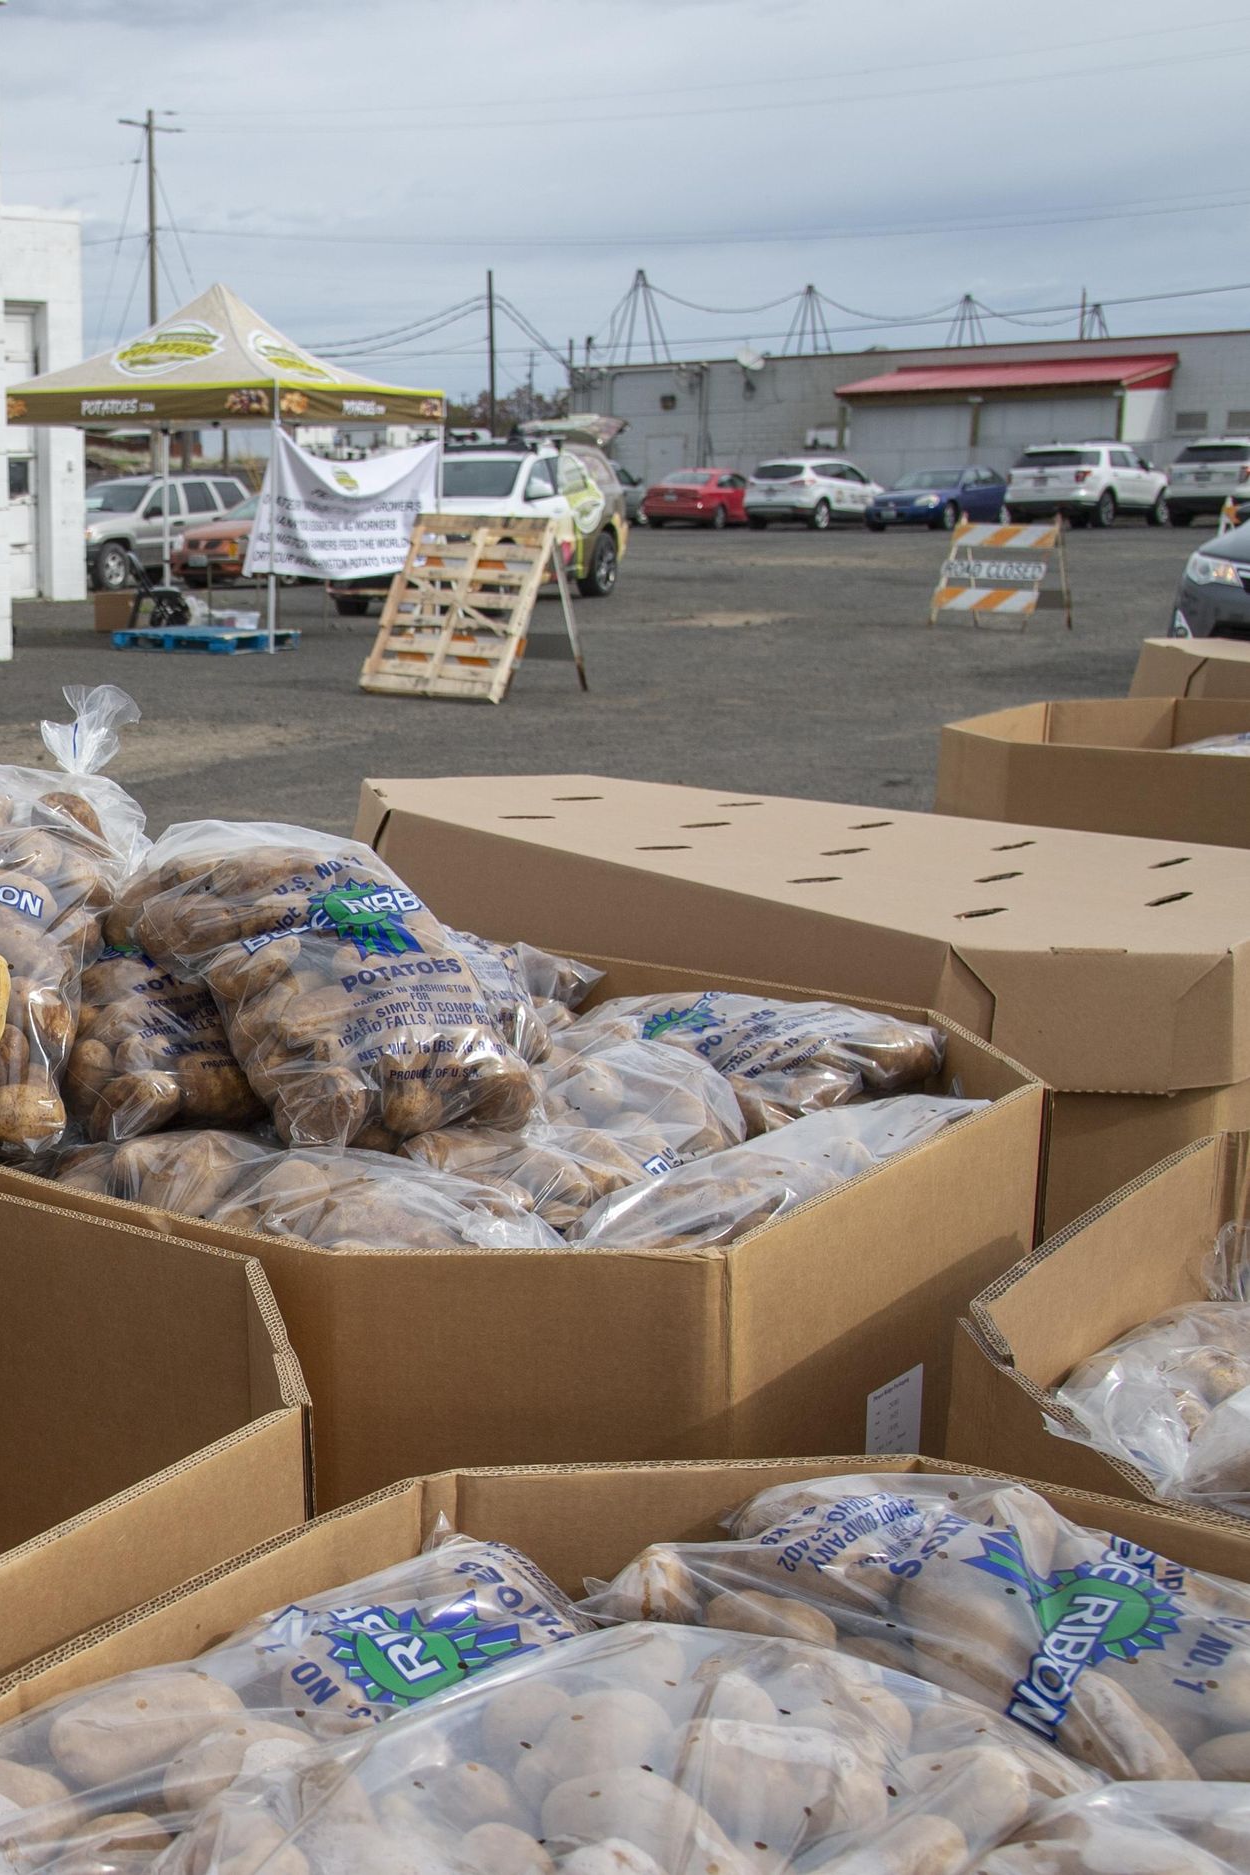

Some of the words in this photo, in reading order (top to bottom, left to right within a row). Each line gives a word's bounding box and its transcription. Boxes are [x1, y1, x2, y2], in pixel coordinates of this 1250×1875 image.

[80, 399, 139, 416] POTATOES
[986, 561, 1043, 580] CLOSED
[272, 876, 314, 895] U.S.
[314, 859, 350, 881] NO.
[340, 890, 422, 915] RIBB
[340, 958, 462, 993] POTATOES
[353, 989, 394, 1008] PACKED
[396, 986, 408, 994] IN
[410, 984, 472, 994] WASHINGTON
[410, 993, 431, 1001] FOR
[344, 1016, 373, 1033] J.R.
[376, 1001, 434, 1019] SIMPLOT
[438, 1001, 487, 1014] COMPAN
[338, 1020, 382, 1048] IDAHO
[434, 1013, 473, 1026] IDAHO
[783, 1035, 800, 1049] 15
[357, 1045, 385, 1062] NET
[781, 1043, 820, 1076] PRODUCE
[389, 1068, 433, 1081] PRODUCE
[436, 1069, 448, 1079] OF
[1183, 1633, 1233, 1668] NO.
[1005, 1593, 1125, 1743] RIBBON
